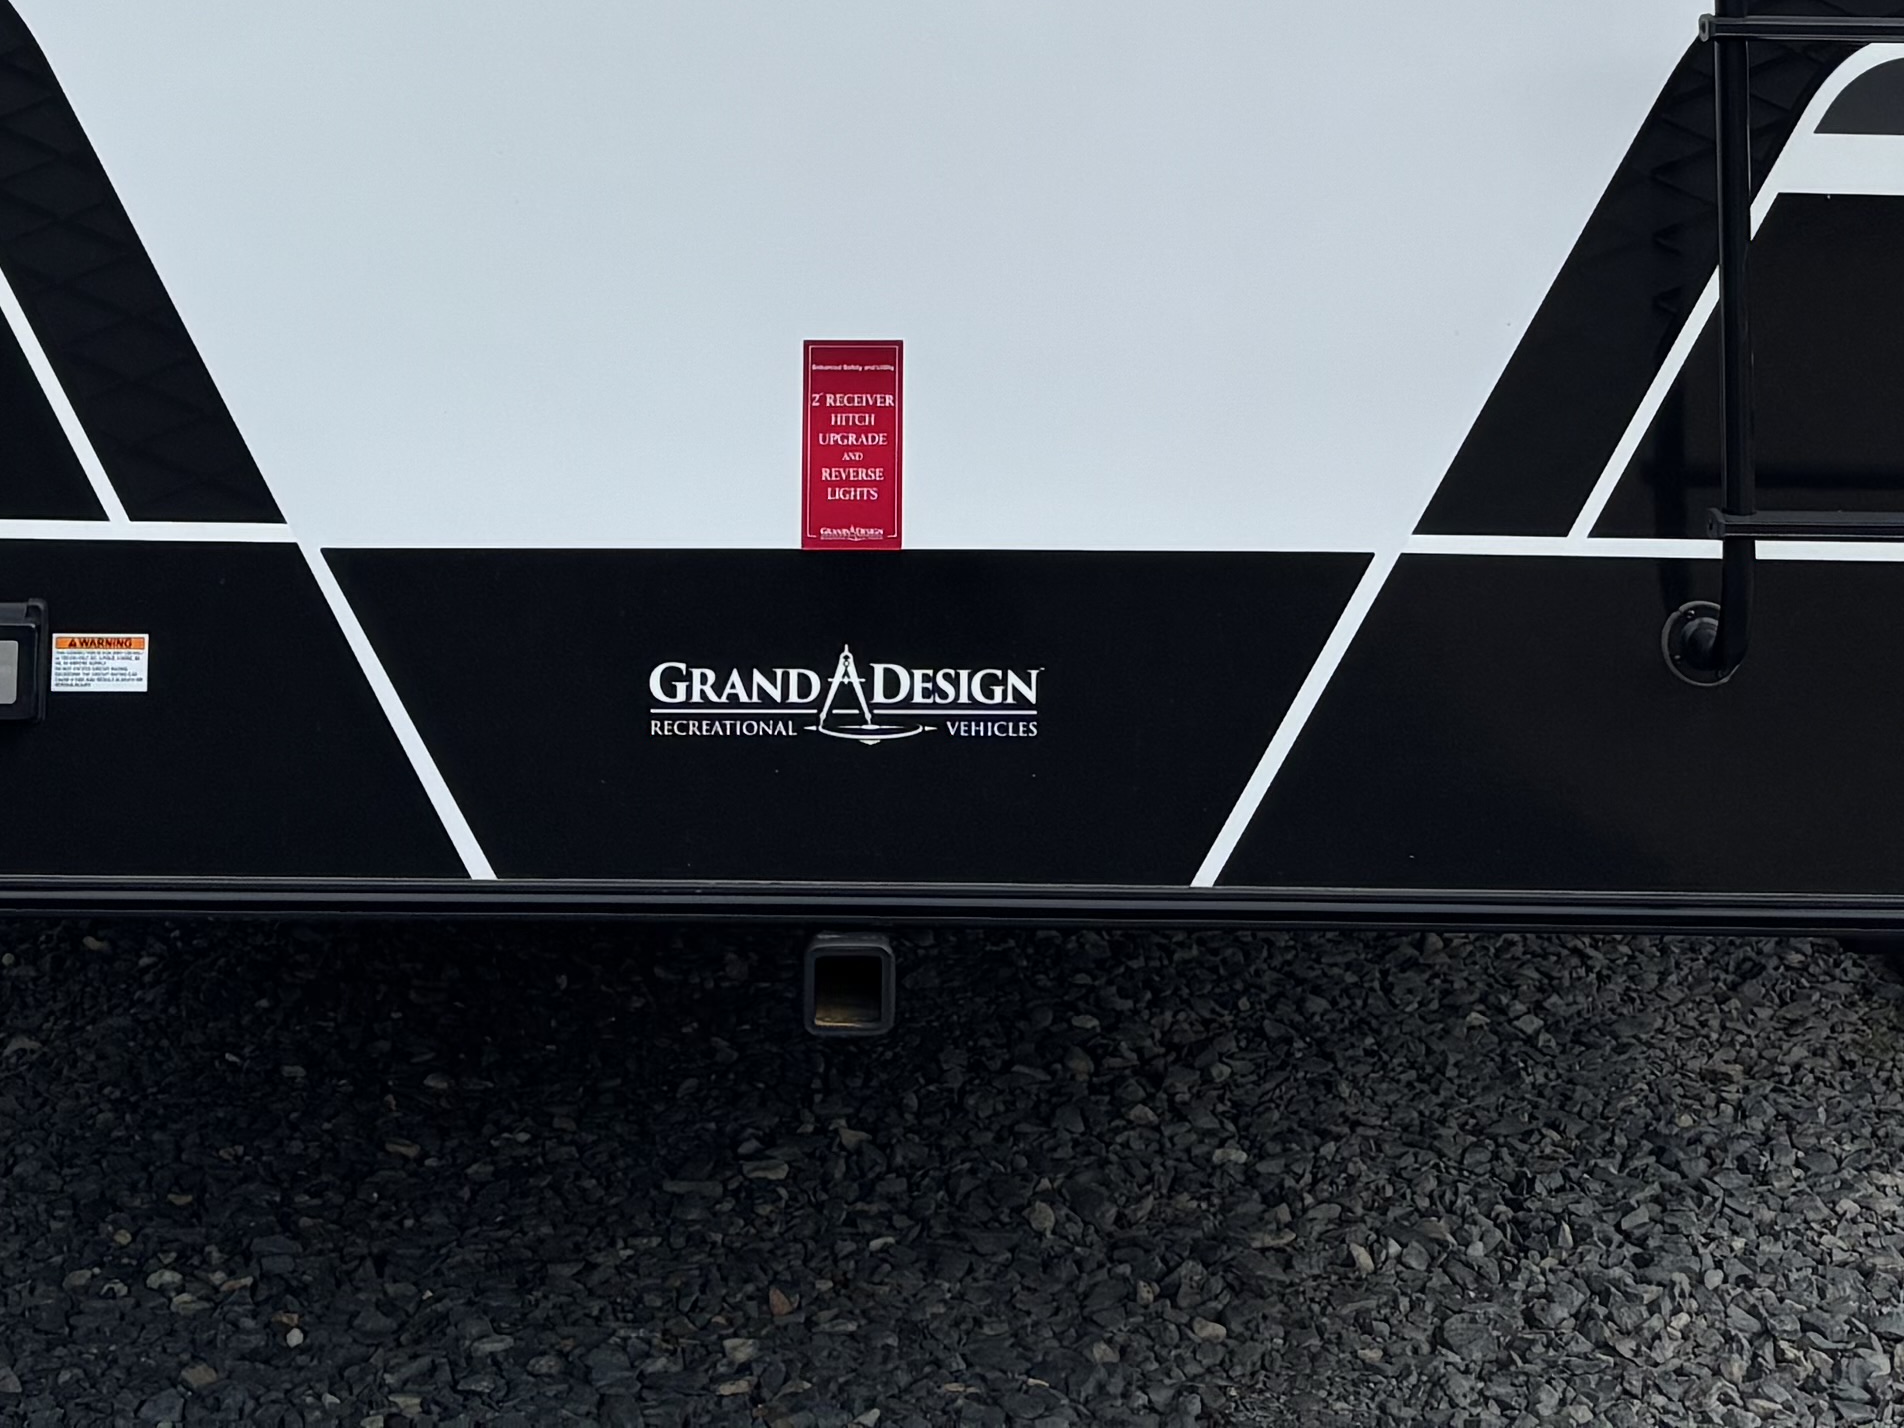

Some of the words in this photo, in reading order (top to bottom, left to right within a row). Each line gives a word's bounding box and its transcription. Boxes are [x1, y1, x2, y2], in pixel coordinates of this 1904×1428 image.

[826, 394, 894, 406] RECEIVER
[831, 414, 875, 426] HITCH
[819, 433, 887, 445] UPGRADE
[842, 452, 863, 461] AND
[822, 468, 884, 480] REVERSE
[827, 487, 878, 500] LIGHTS
[78, 638, 132, 647] WARNING
[649, 661, 820, 704] GRAND
[869, 662, 1037, 704] DESIGN
[650, 720, 797, 737] RECREATIONAL
[947, 721, 1037, 737] VEHICLES
